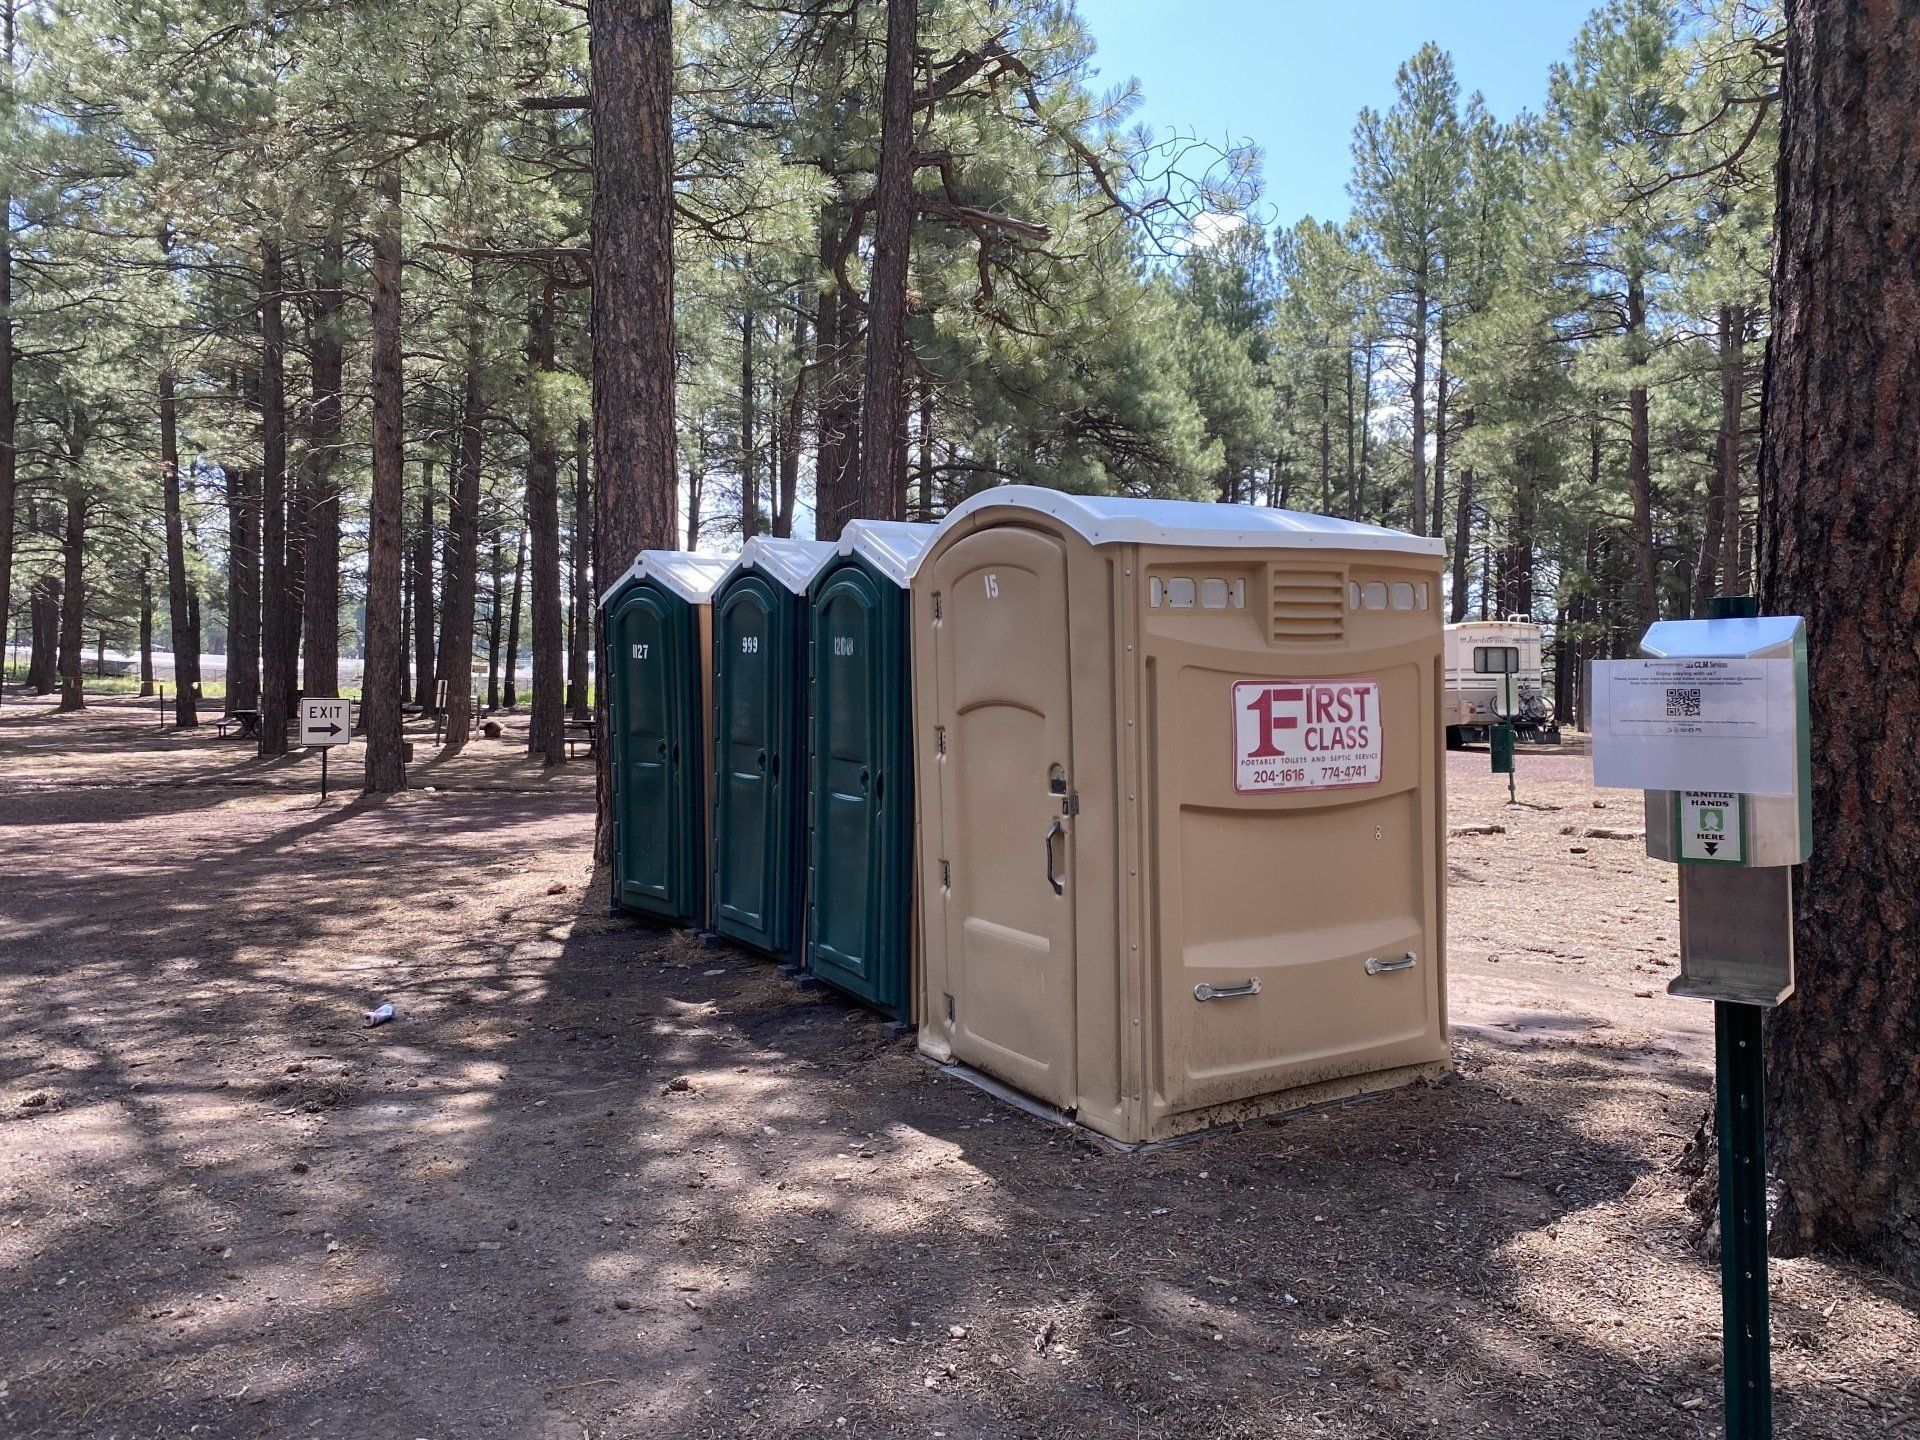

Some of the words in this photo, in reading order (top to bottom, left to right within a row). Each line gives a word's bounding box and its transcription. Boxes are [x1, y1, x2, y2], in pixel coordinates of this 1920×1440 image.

[984, 574, 999, 599] 15
[632, 644, 648, 659] 1127
[742, 636, 758, 653] 999
[1694, 661, 1709, 669] CLM
[309, 706, 342, 719] EXIT
[1305, 725, 1369, 752] CLASS
[1254, 768, 1305, 783] 204-1616
[1321, 765, 1367, 780] 774-4741
